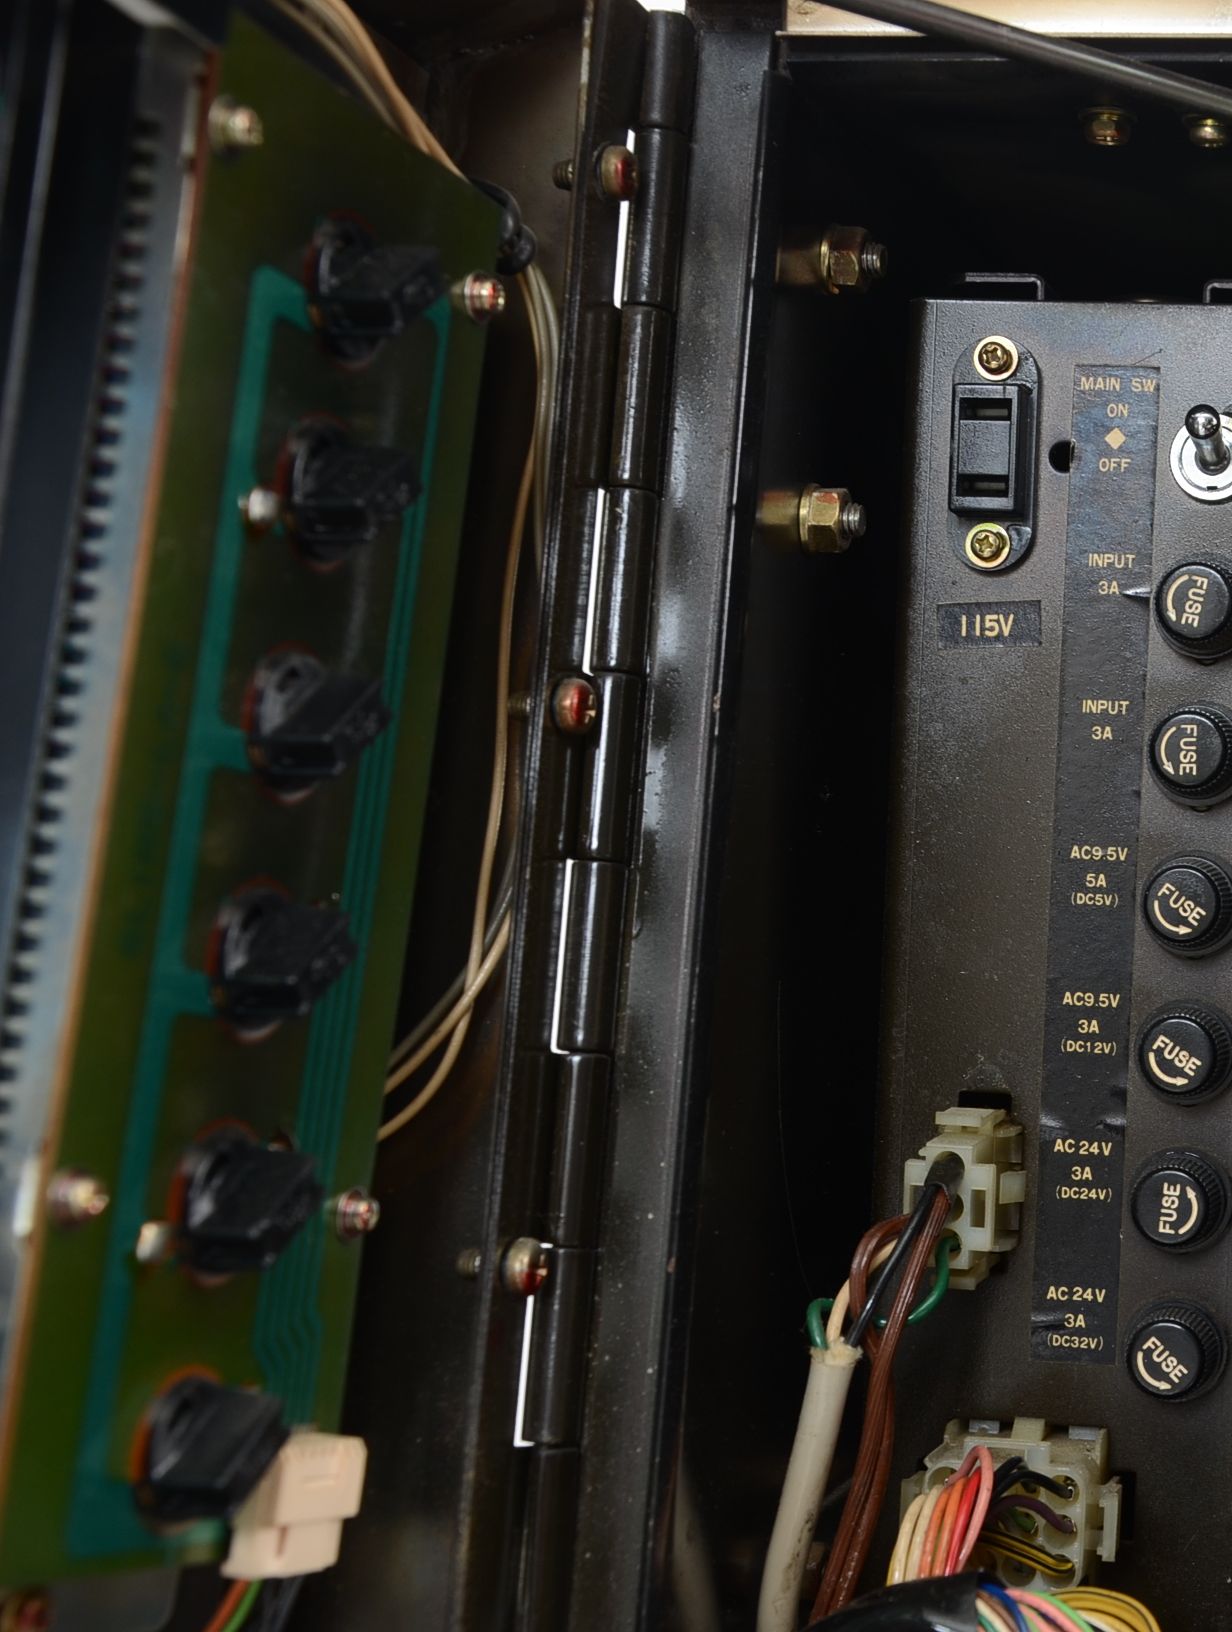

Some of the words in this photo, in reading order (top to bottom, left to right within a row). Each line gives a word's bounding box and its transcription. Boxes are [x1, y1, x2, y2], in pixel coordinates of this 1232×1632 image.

[1080, 376, 1121, 391] MAIN
[1131, 378, 1156, 392] SW
[1107, 404, 1128, 417] ON
[1099, 458, 1131, 472] OFF
[1088, 554, 1136, 568] INPUT
[1098, 580, 1119, 595] 3A
[1180, 575, 1208, 628] FUSE
[960, 613, 1014, 637] 115V
[1082, 699, 1130, 715] INPUT
[1091, 726, 1113, 740] 3A
[1179, 724, 1197, 776] FUSE
[1070, 845, 1128, 861] AC9.5V
[1086, 873, 1107, 888] 5A
[1070, 892, 1118, 907] (DC5V)
[1157, 883, 1206, 926] FUSE
[1062, 992, 1120, 1008] AC9.5V
[1077, 1020, 1100, 1034] 3A
[1060, 1039, 1117, 1055] (DC12V)
[1152, 1035, 1202, 1076] FUSE
[1053, 1138, 1076, 1153] AC
[1079, 1141, 1112, 1156] 24V
[1071, 1167, 1093, 1181] 3A
[1055, 1186, 1112, 1202] (DC24V)
[1158, 1183, 1180, 1234] FUSE
[1046, 1286, 1069, 1301] AC
[1072, 1287, 1106, 1303] 24V
[1064, 1314, 1086, 1328] 3A
[1047, 1335, 1103, 1350] (DC32V)
[1142, 1336, 1188, 1383] FUSE
